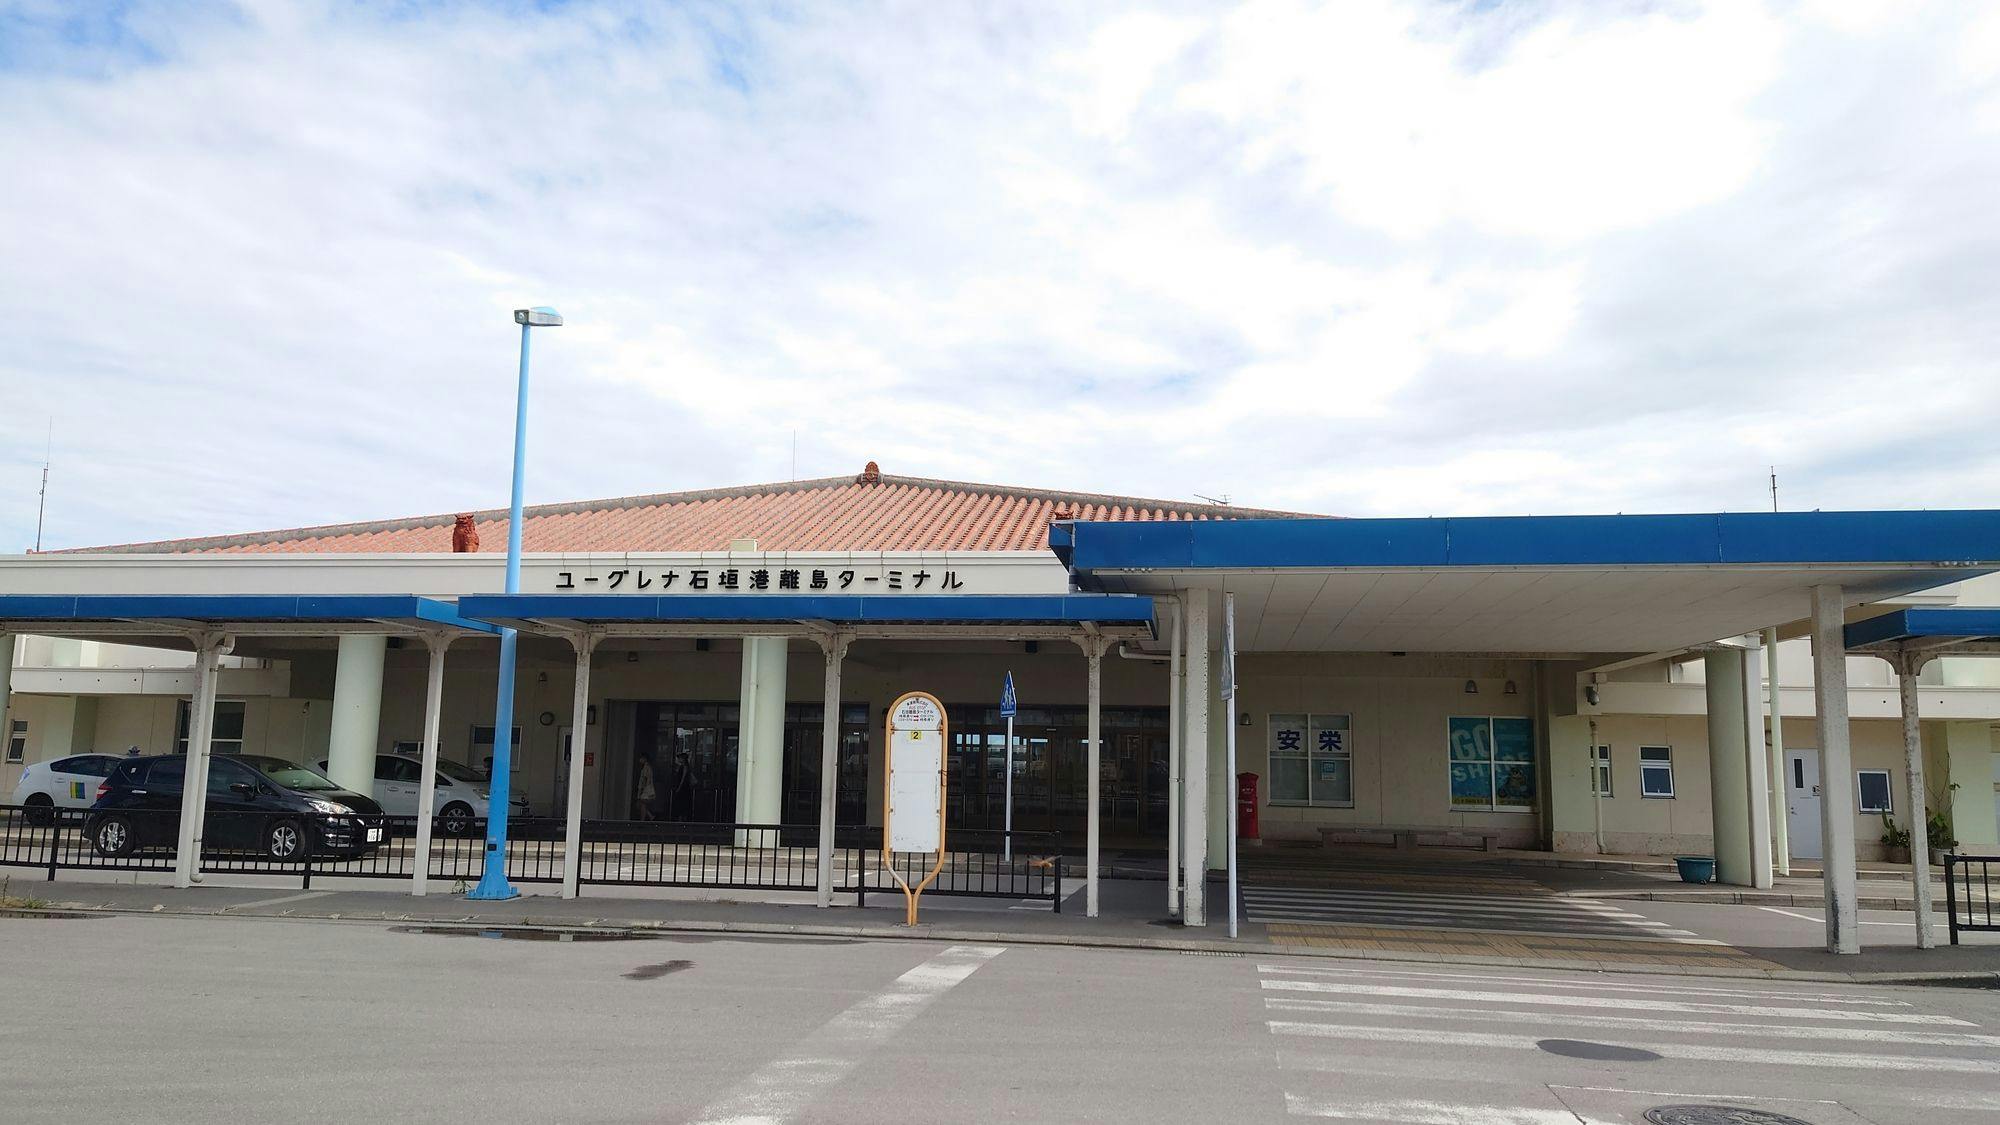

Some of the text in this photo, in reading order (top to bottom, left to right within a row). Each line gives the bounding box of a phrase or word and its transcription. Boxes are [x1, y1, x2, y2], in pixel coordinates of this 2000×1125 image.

[556, 569, 964, 589] ユーグレナ石垣港離島ターミナル
[913, 731, 919, 739] 2
[1277, 729, 1342, 751] 安栄
[1452, 723, 1499, 760] GO
[1451, 752, 1530, 782] SHRE
